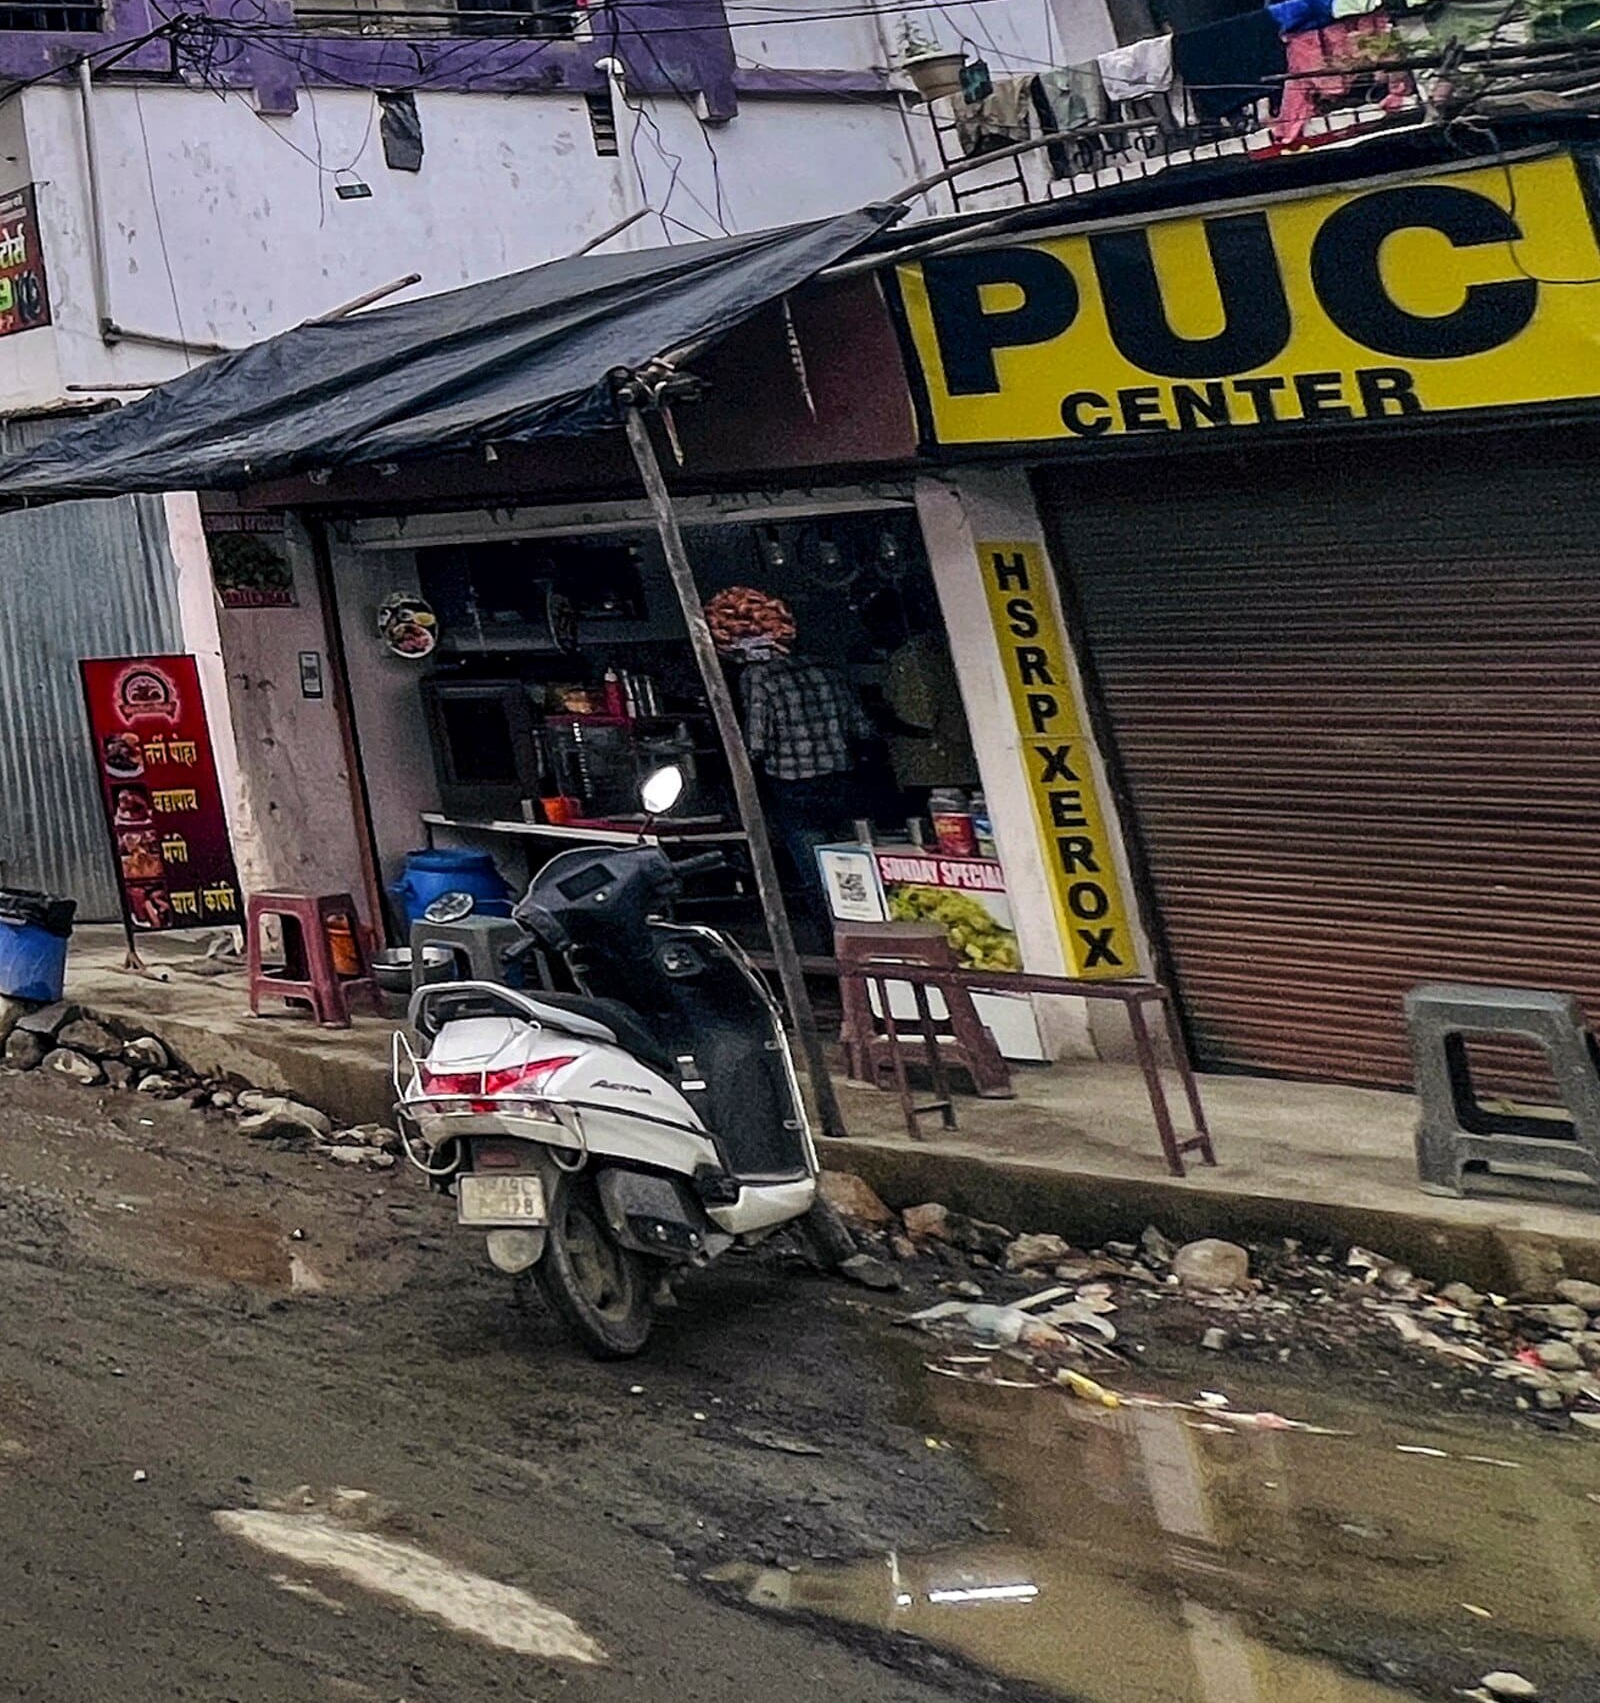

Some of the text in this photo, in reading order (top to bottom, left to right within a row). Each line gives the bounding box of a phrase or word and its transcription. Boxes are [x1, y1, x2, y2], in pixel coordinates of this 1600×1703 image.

[925, 185, 1538, 397] PUC
[1060, 368, 1425, 436] CENTER
[992, 552, 1124, 969] HSRP XEROX
[879, 856, 938, 885] SUNDAY
